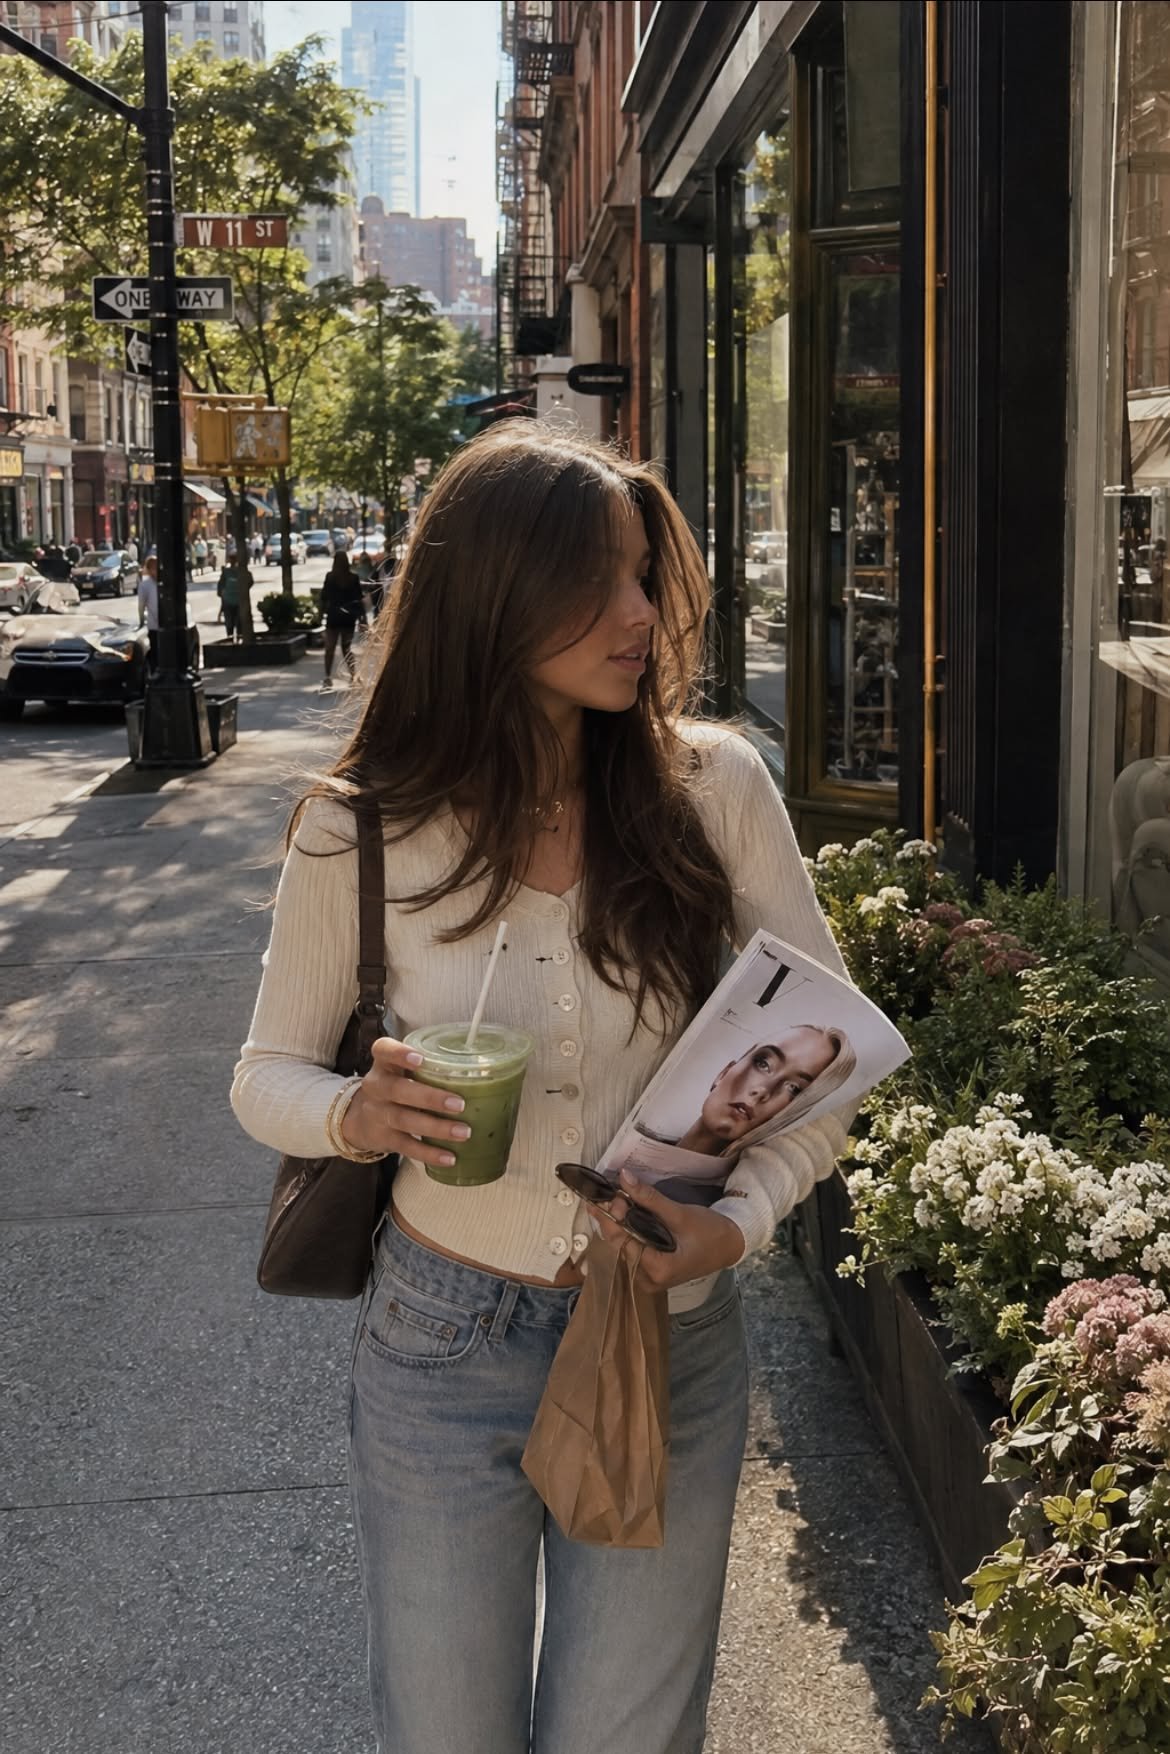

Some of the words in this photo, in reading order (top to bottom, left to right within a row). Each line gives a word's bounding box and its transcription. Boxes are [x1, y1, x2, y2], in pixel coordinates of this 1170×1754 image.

[196, 220, 213, 246] W
[226, 220, 243, 246] 11
[255, 220, 274, 237] ST
[114, 290, 151, 307] ONE
[176, 290, 217, 307] WAY
